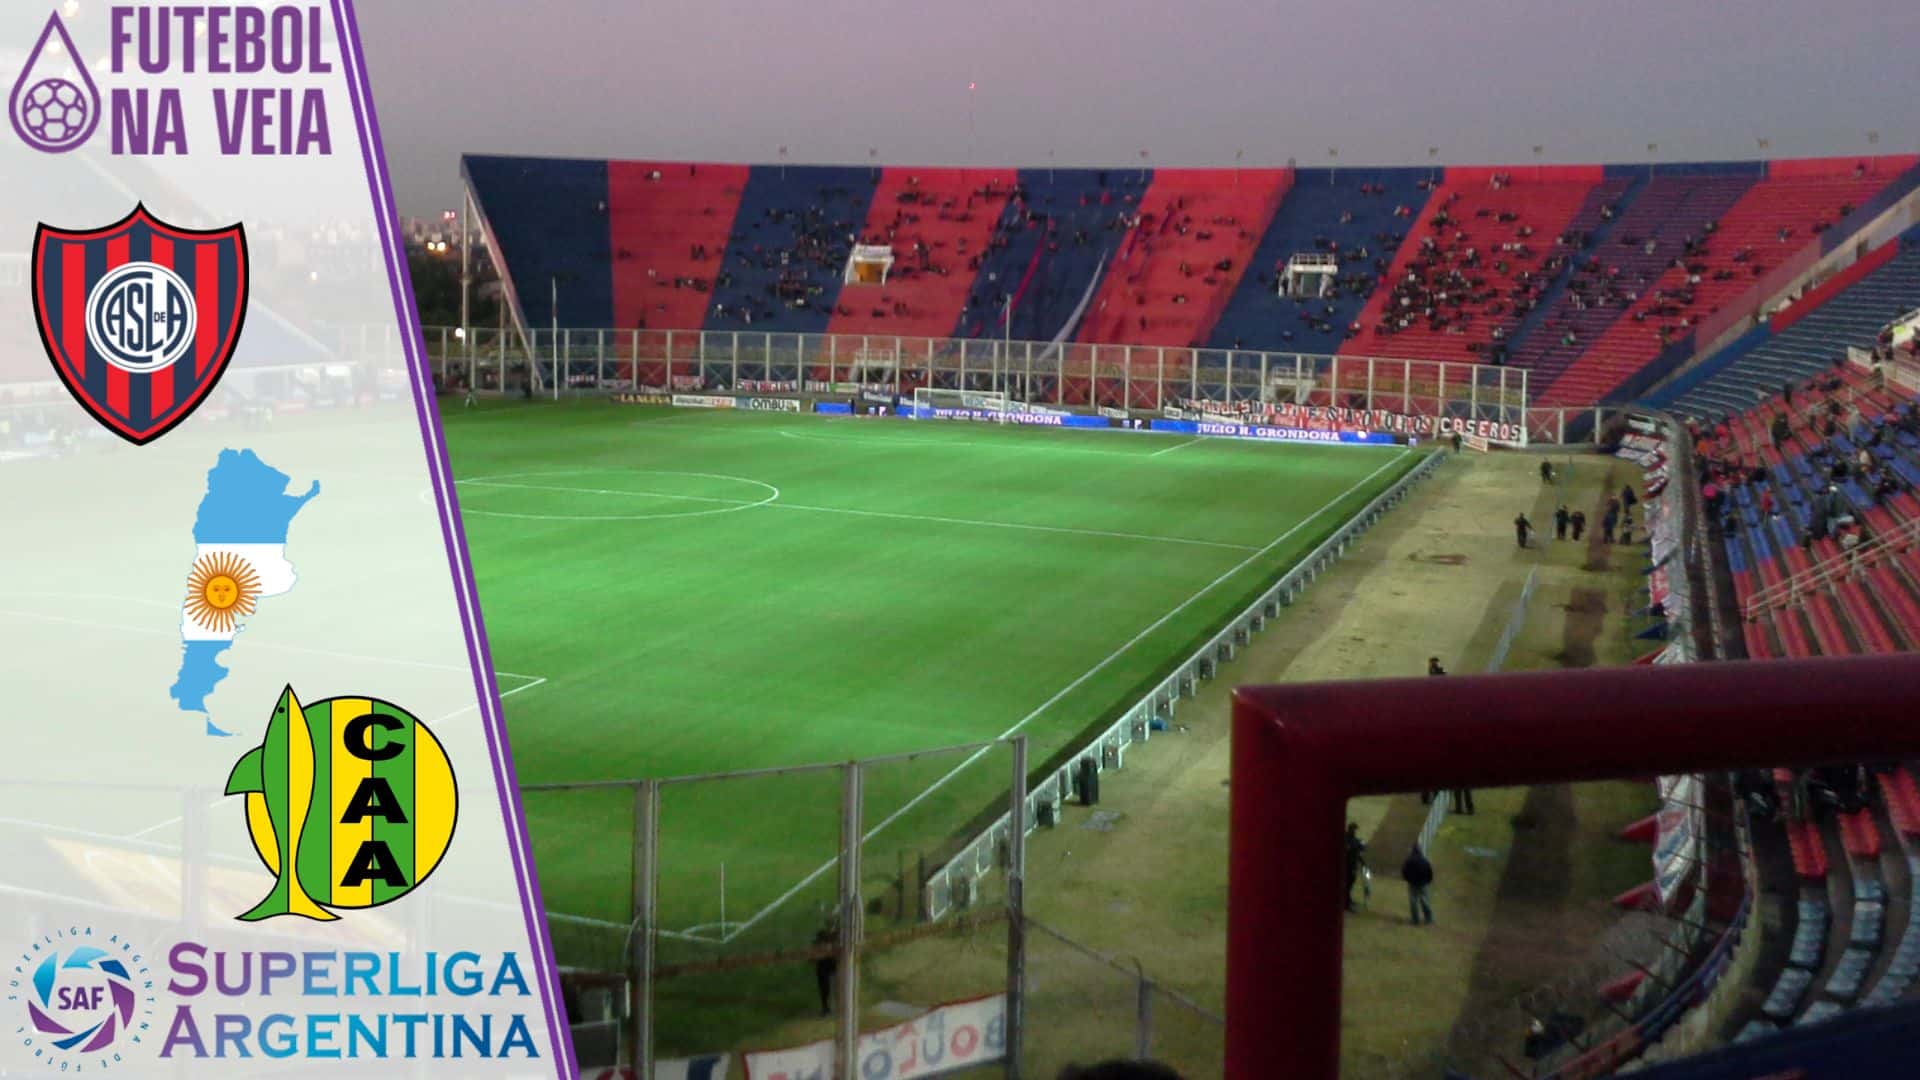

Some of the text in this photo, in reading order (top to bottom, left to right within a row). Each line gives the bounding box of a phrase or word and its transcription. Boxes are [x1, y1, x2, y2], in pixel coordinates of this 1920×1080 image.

[1197, 424, 1340, 440] JULIO H. GRONDONA
[1440, 417, 1521, 441] CASEROS
